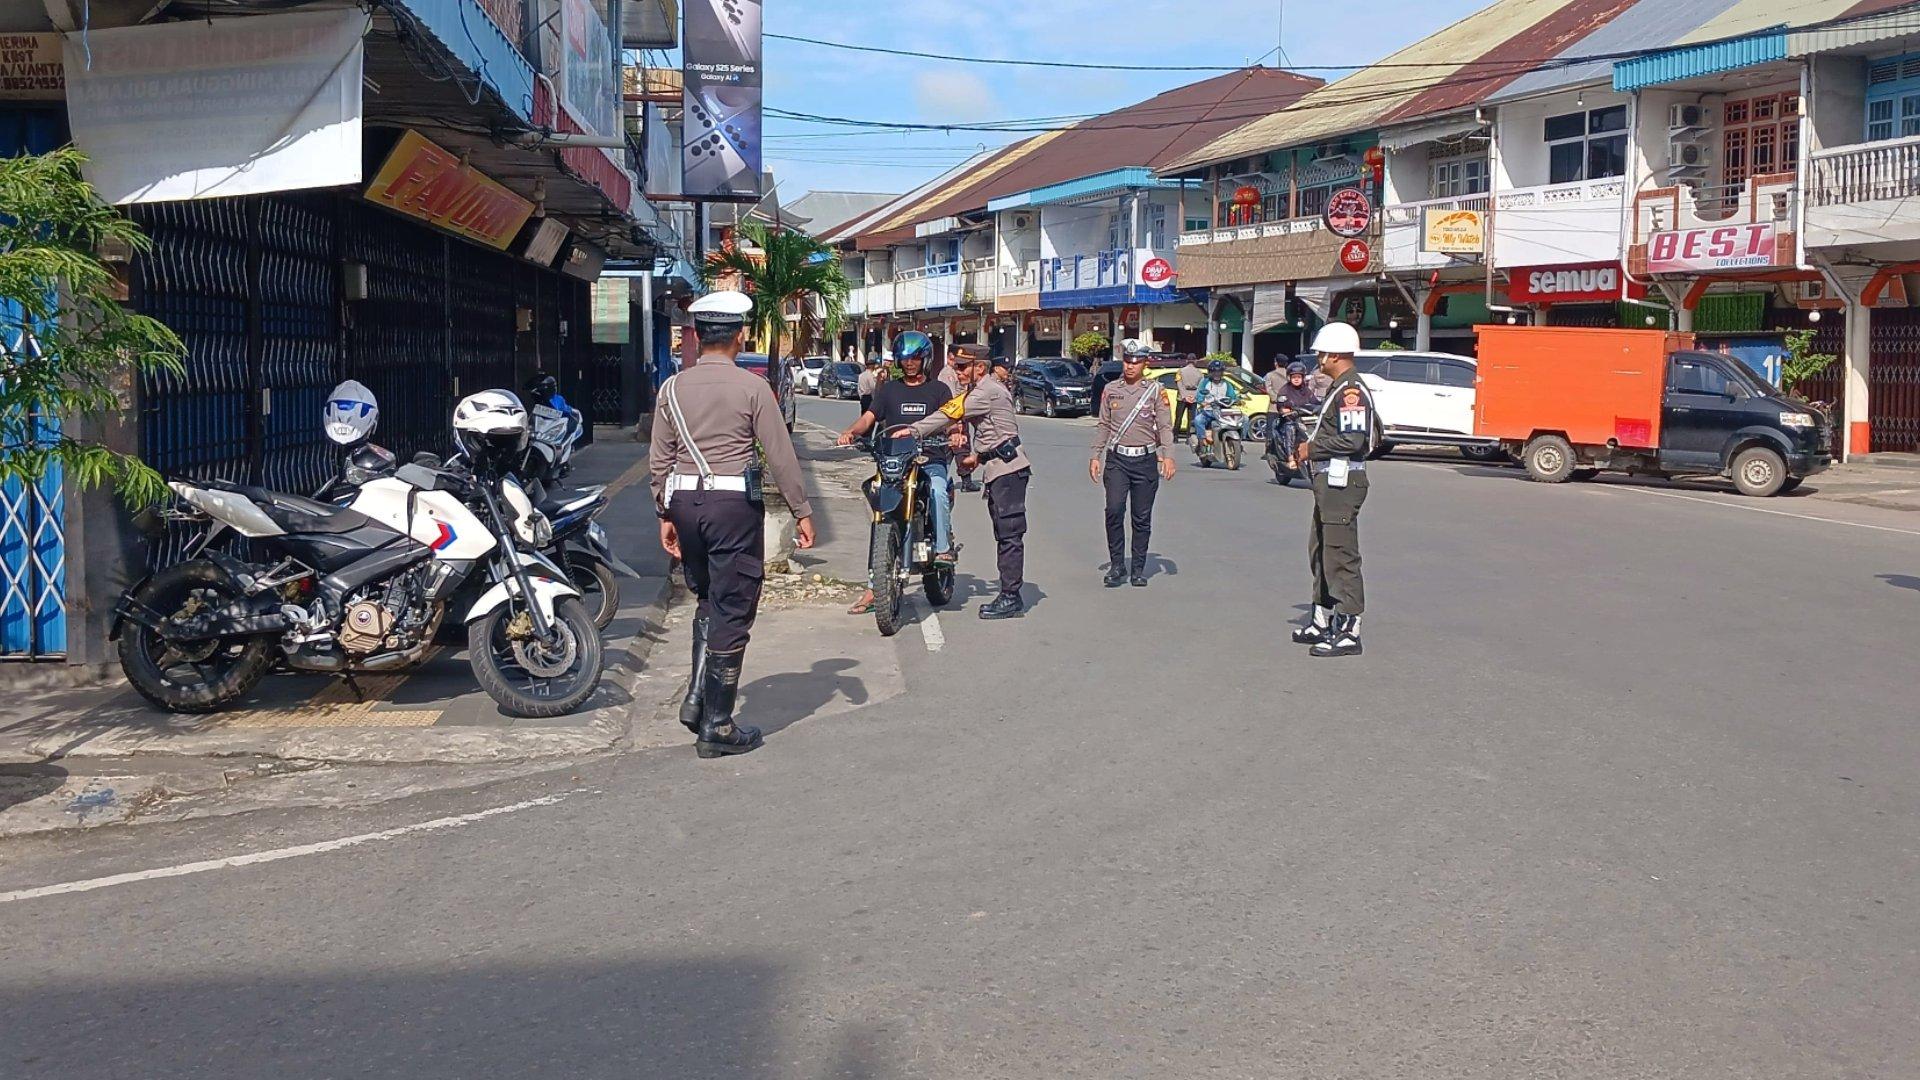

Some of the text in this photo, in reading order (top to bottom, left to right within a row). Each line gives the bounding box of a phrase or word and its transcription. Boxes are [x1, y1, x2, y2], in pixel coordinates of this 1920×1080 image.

[686, 63, 755, 73] Galaxy S25 Series
[701, 73, 725, 81] Galaxy
[1651, 224, 1771, 261] BEST
[1715, 256, 1769, 267] COLLECTIONS
[1528, 268, 1617, 294] semua
[1340, 410, 1366, 432] PM
